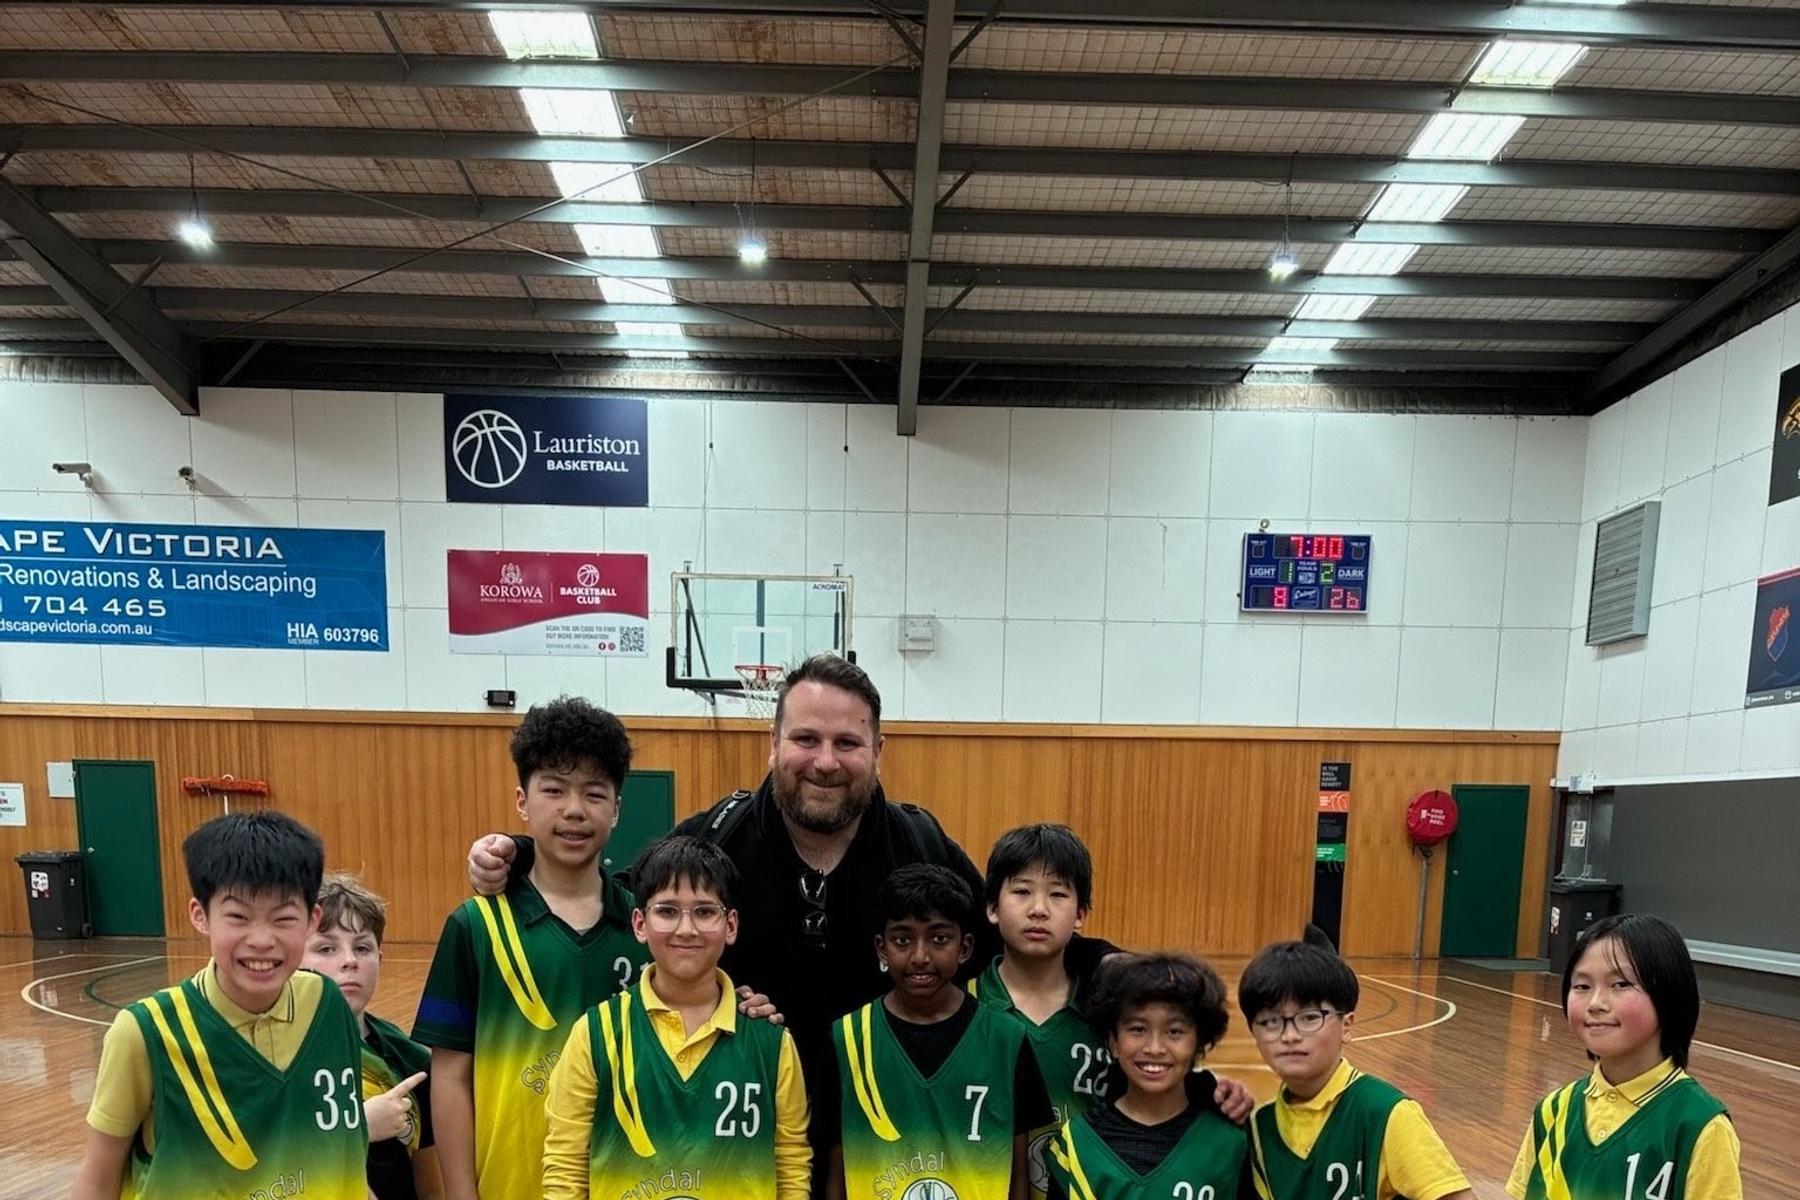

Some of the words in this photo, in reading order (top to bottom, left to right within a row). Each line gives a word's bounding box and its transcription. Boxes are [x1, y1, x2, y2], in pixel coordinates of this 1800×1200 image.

[532, 430, 641, 455] Lauriston
[546, 459, 629, 473] BASKETBALL
[1290, 536, 1343, 558] 7:00
[147, 567, 164, 590] &
[172, 568, 317, 598] Landscaping
[1249, 567, 1276, 577] LIGHT
[1321, 563, 1334, 583] 2
[1338, 569, 1364, 578] DARK
[479, 584, 543, 598] KOROWA
[560, 586, 617, 597] BASKETBALL
[576, 595, 601, 605] CLUB
[1273, 586, 1287, 608] 8
[23, 595, 88, 615] 704
[102, 598, 167, 617] 465
[286, 622, 319, 638] HIA
[323, 627, 379, 643] 603796
[1071, 1042, 1112, 1098] 22
[313, 1067, 361, 1131] 33
[714, 1080, 761, 1138] 25
[965, 1084, 989, 1141] 7
